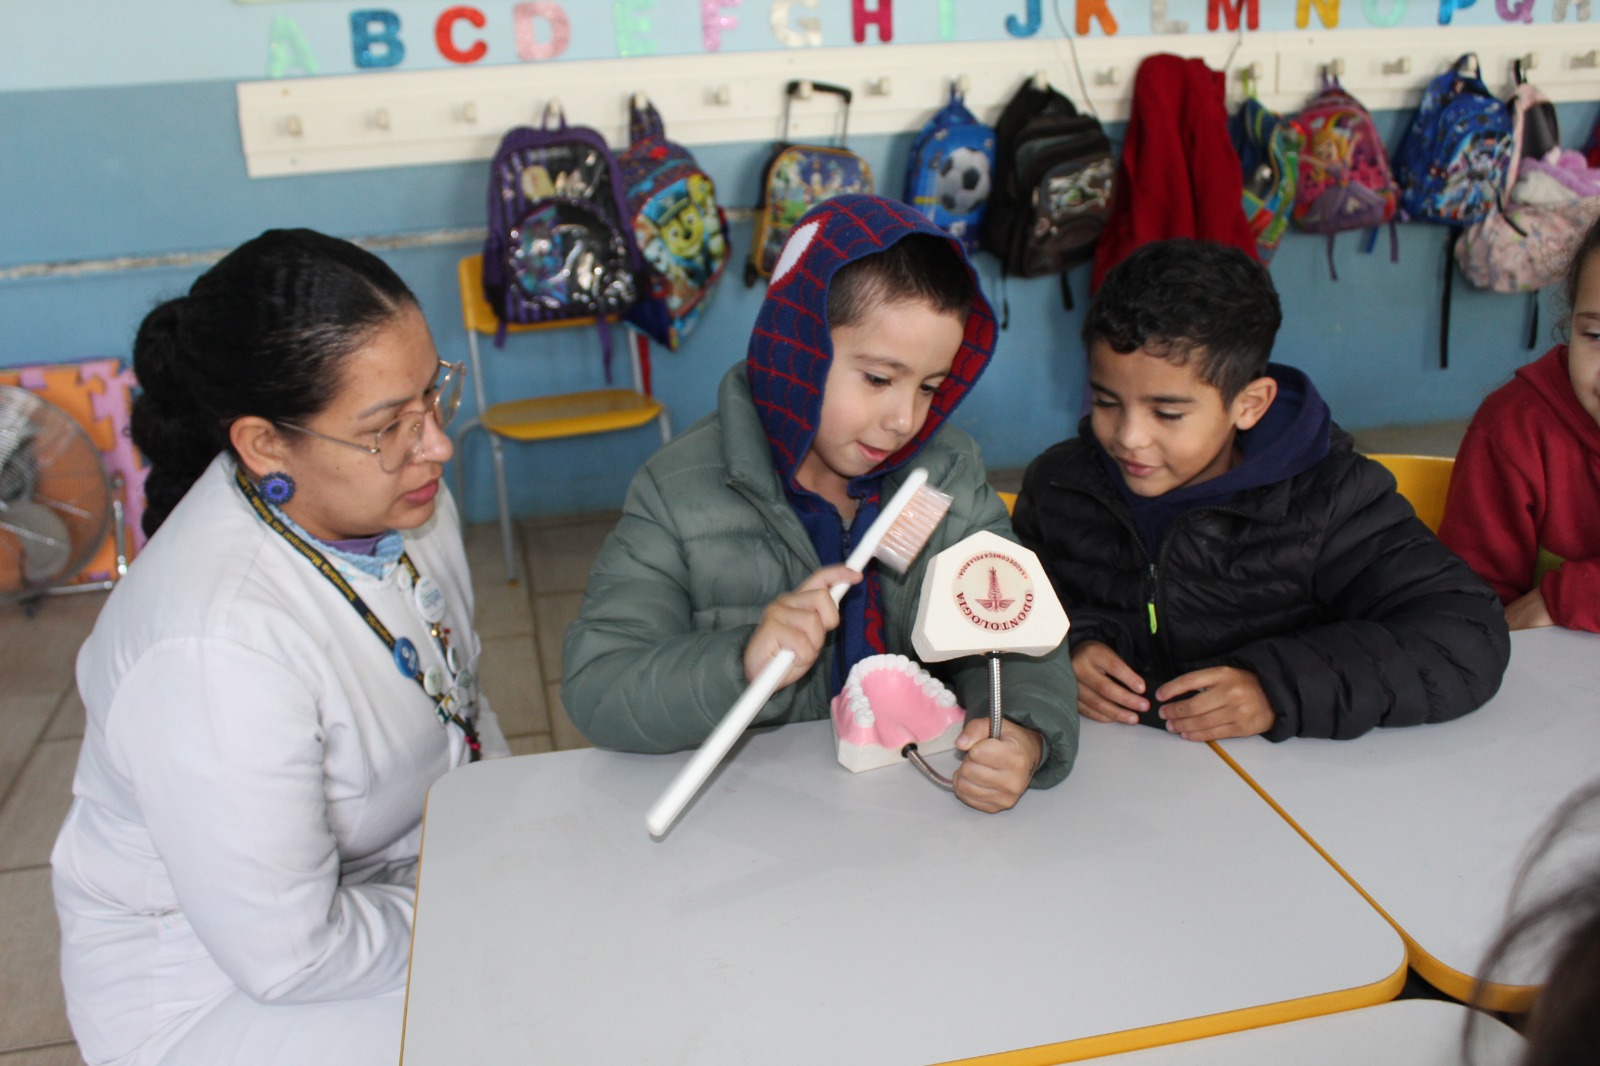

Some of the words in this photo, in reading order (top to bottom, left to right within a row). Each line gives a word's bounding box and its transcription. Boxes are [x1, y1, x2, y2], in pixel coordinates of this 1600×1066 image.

[266, 13, 319, 79] A
[349, 9, 405, 69] B
[434, 5, 488, 64] C
[513, 1, 570, 62] D
[613, 0, 657, 58] E
[701, 0, 738, 51] F
[770, 0, 821, 47] G
[852, 0, 893, 44] H
[1005, 0, 1041, 38] J
[1075, 0, 1118, 36] K
[1207, 0, 1260, 32] M
[283, 531, 322, 566] Municipal
[956, 592, 1033, 630] ODONTOLOGIA
